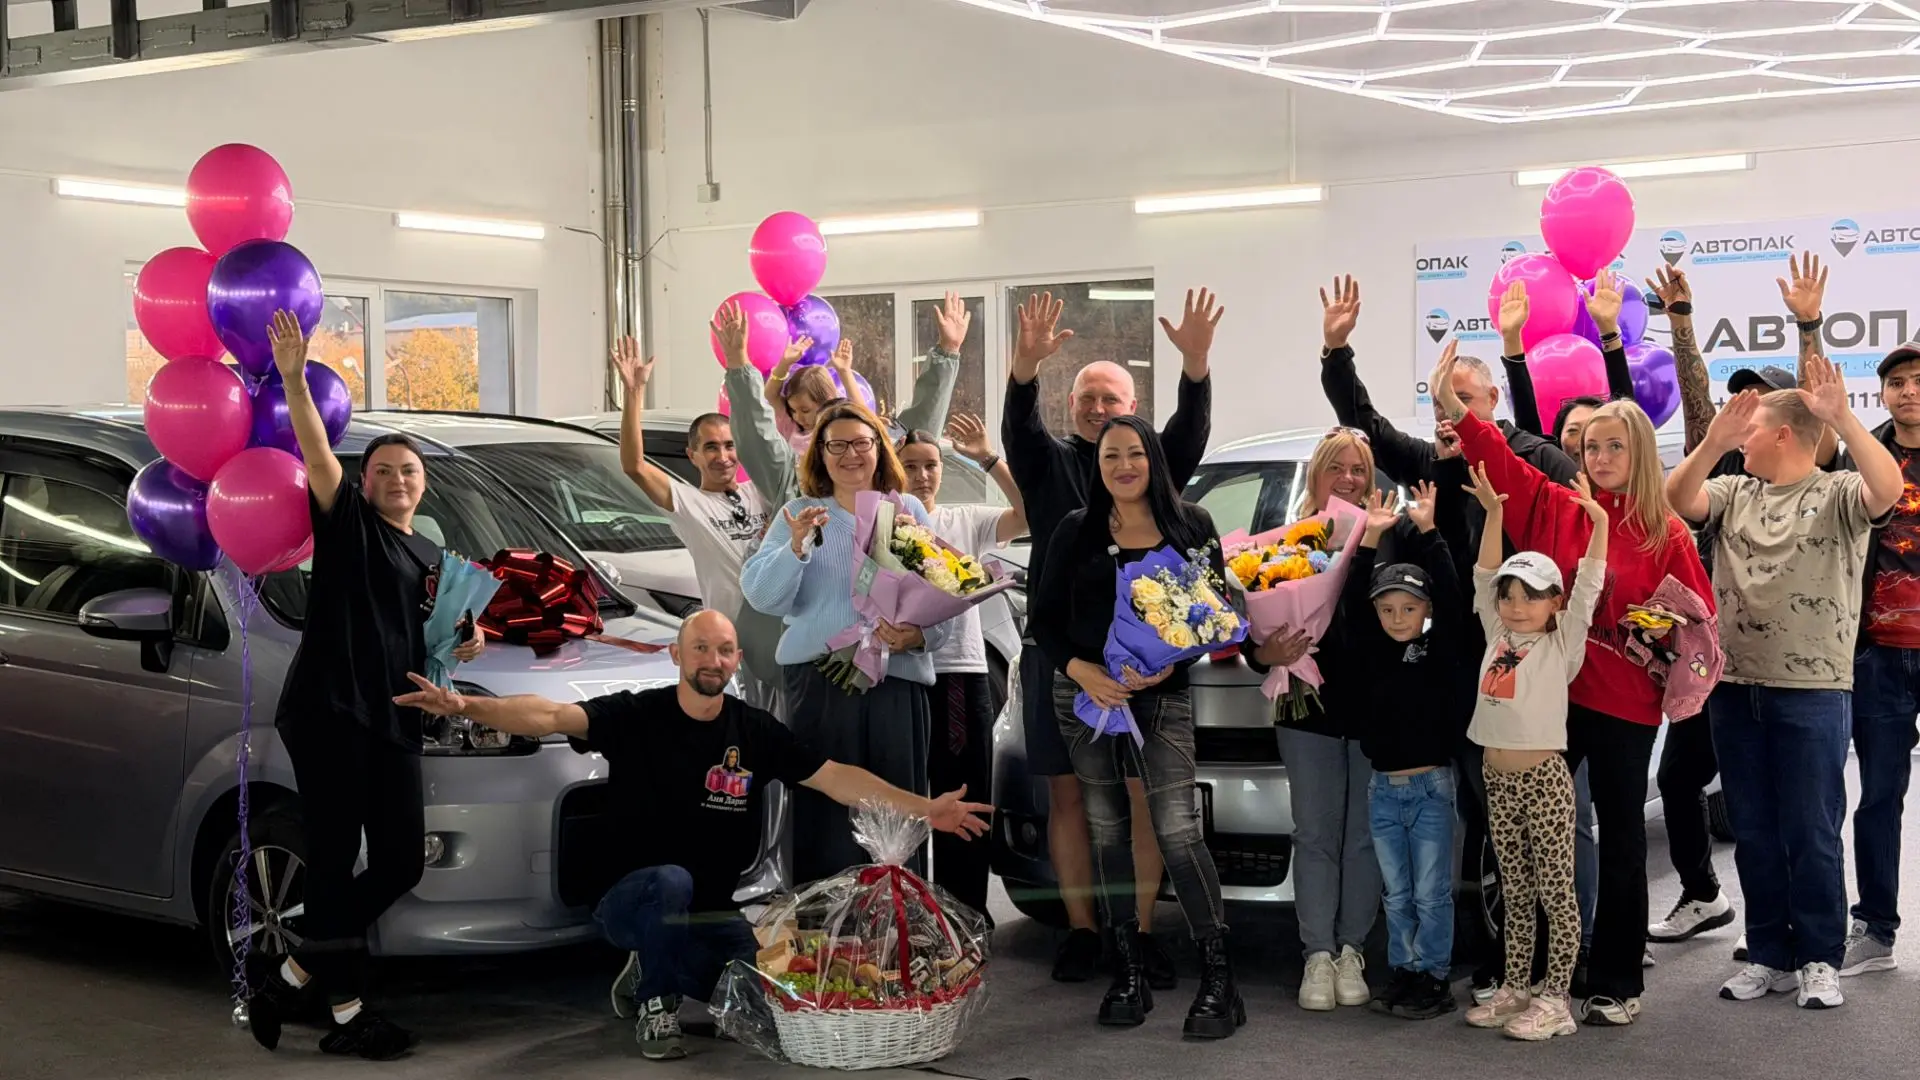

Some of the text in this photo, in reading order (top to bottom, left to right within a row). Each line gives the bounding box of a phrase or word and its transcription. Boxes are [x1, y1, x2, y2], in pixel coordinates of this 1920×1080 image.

[1690, 235, 1795, 254] АВТОПАК
[1416, 255, 1469, 270] ОПАК
[1453, 317, 1496, 331] АВТ
[1702, 309, 1920, 353] АВОП
